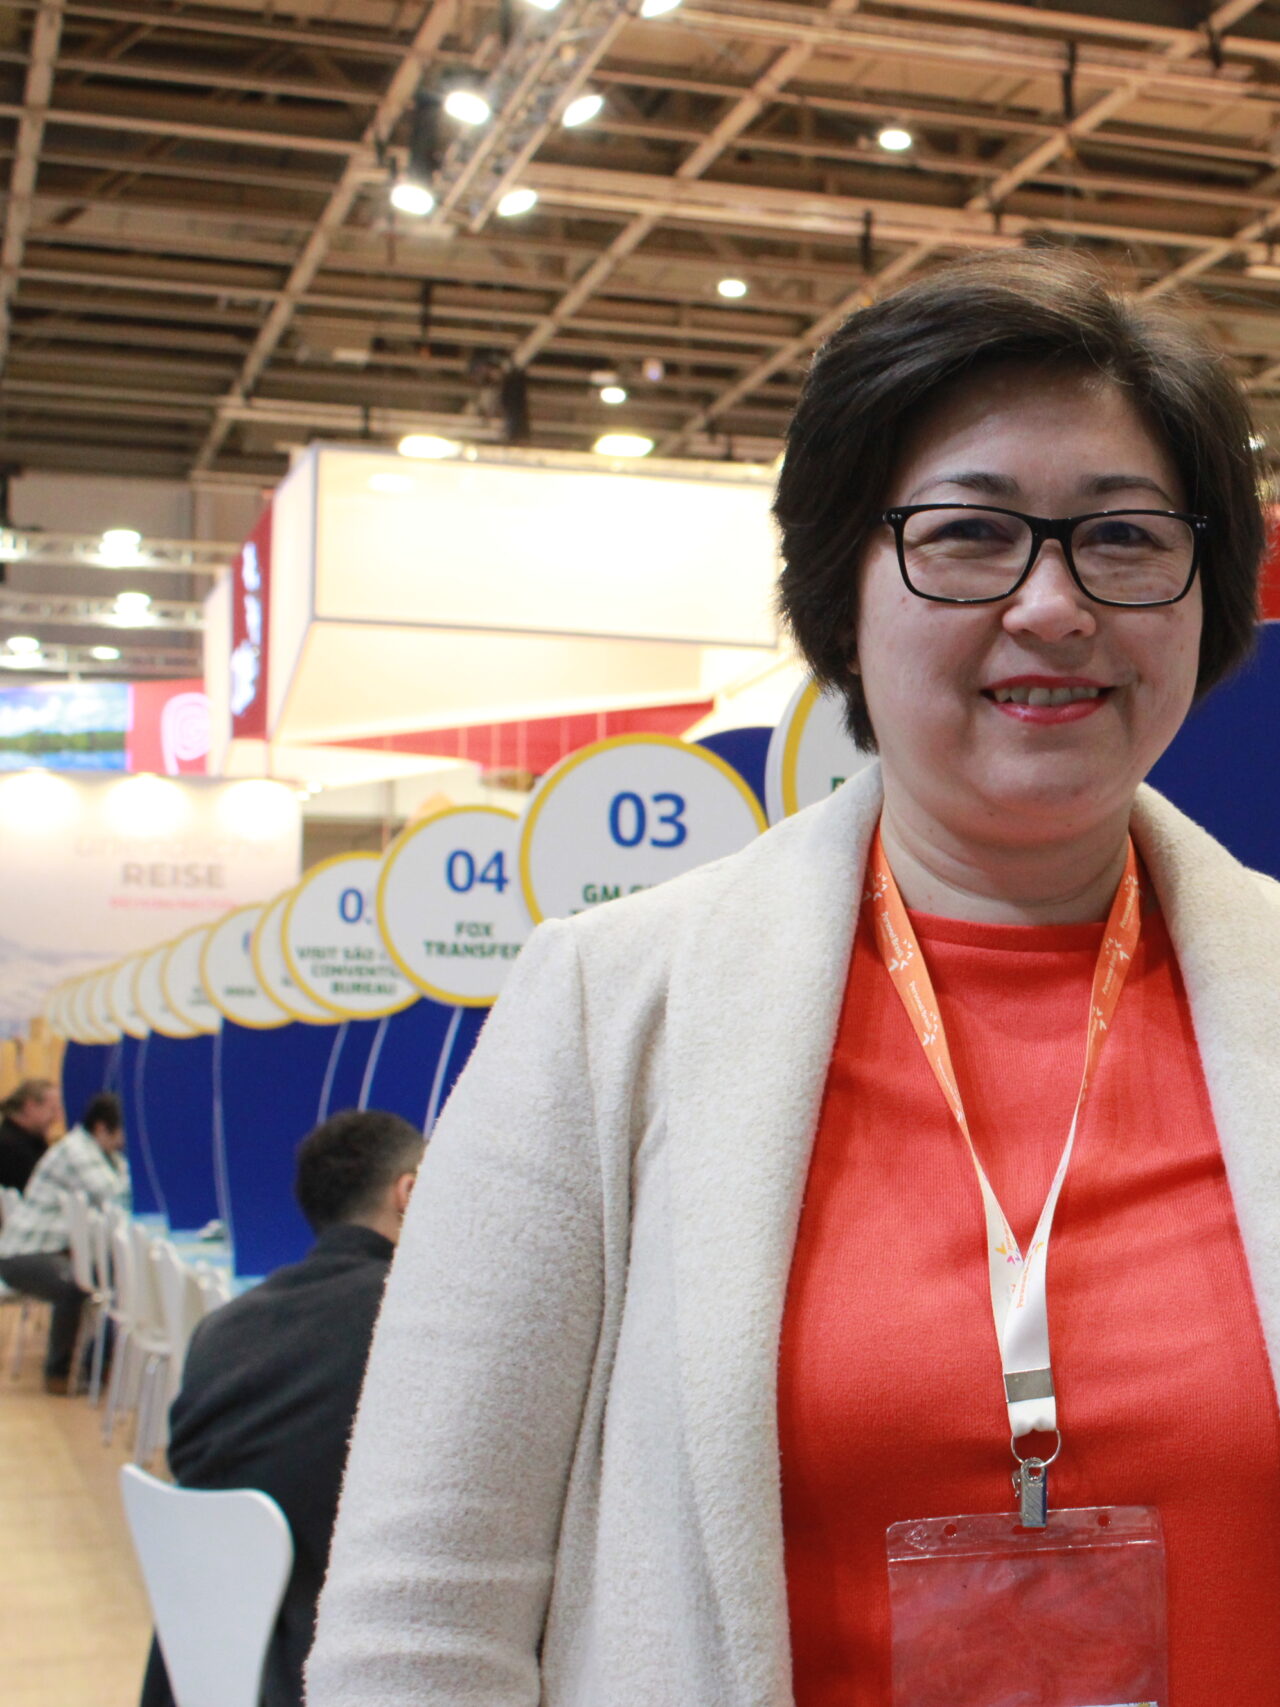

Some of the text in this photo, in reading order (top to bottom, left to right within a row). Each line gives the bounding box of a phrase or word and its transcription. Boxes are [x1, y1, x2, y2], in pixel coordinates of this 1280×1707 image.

[608, 791, 688, 849] 03
[121, 861, 225, 889] REISE
[446, 849, 509, 893] 04
[454, 922, 494, 937] FOX
[331, 981, 397, 995] BUREAU
